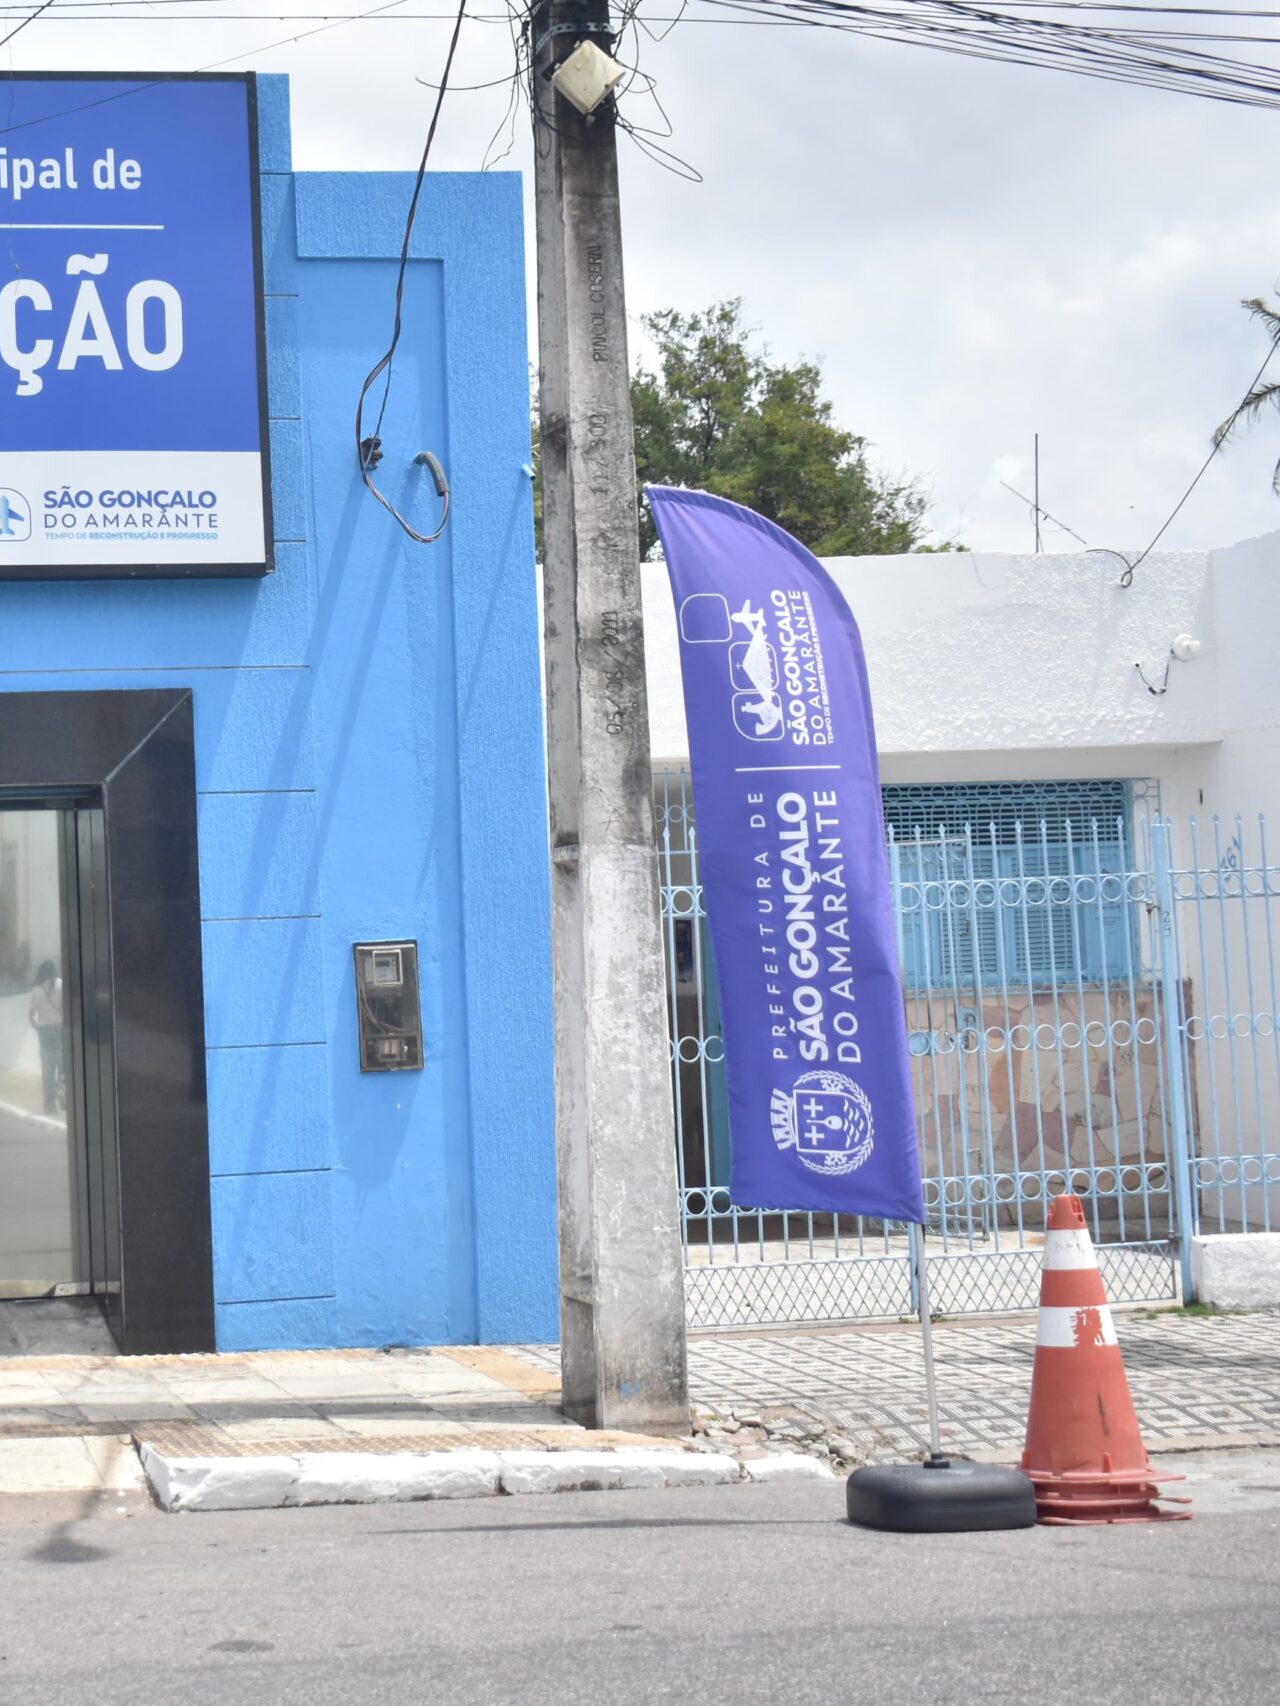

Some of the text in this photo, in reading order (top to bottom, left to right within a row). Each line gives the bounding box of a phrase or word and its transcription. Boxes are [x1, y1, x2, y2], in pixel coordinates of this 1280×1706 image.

[91, 148, 142, 190] de
[587, 245, 605, 303] COSERN
[43, 485, 217, 514] SÃO GONÇALO
[43, 513, 218, 529] DO AMARANTE
[45, 532, 75, 540] TEMPO
[76, 532, 88, 540] DE
[88, 531, 159, 541] RECONSTRUÇÃO
[166, 532, 218, 540] PROGRESSO
[770, 589, 810, 744] SÃO GONÇALO
[788, 590, 827, 745] DO AMARANTE
[748, 793, 788, 1060] PREFEITURA DE
[776, 791, 829, 1061] SÃO GONÇALO
[813, 790, 862, 1064] DO AMARANTE
